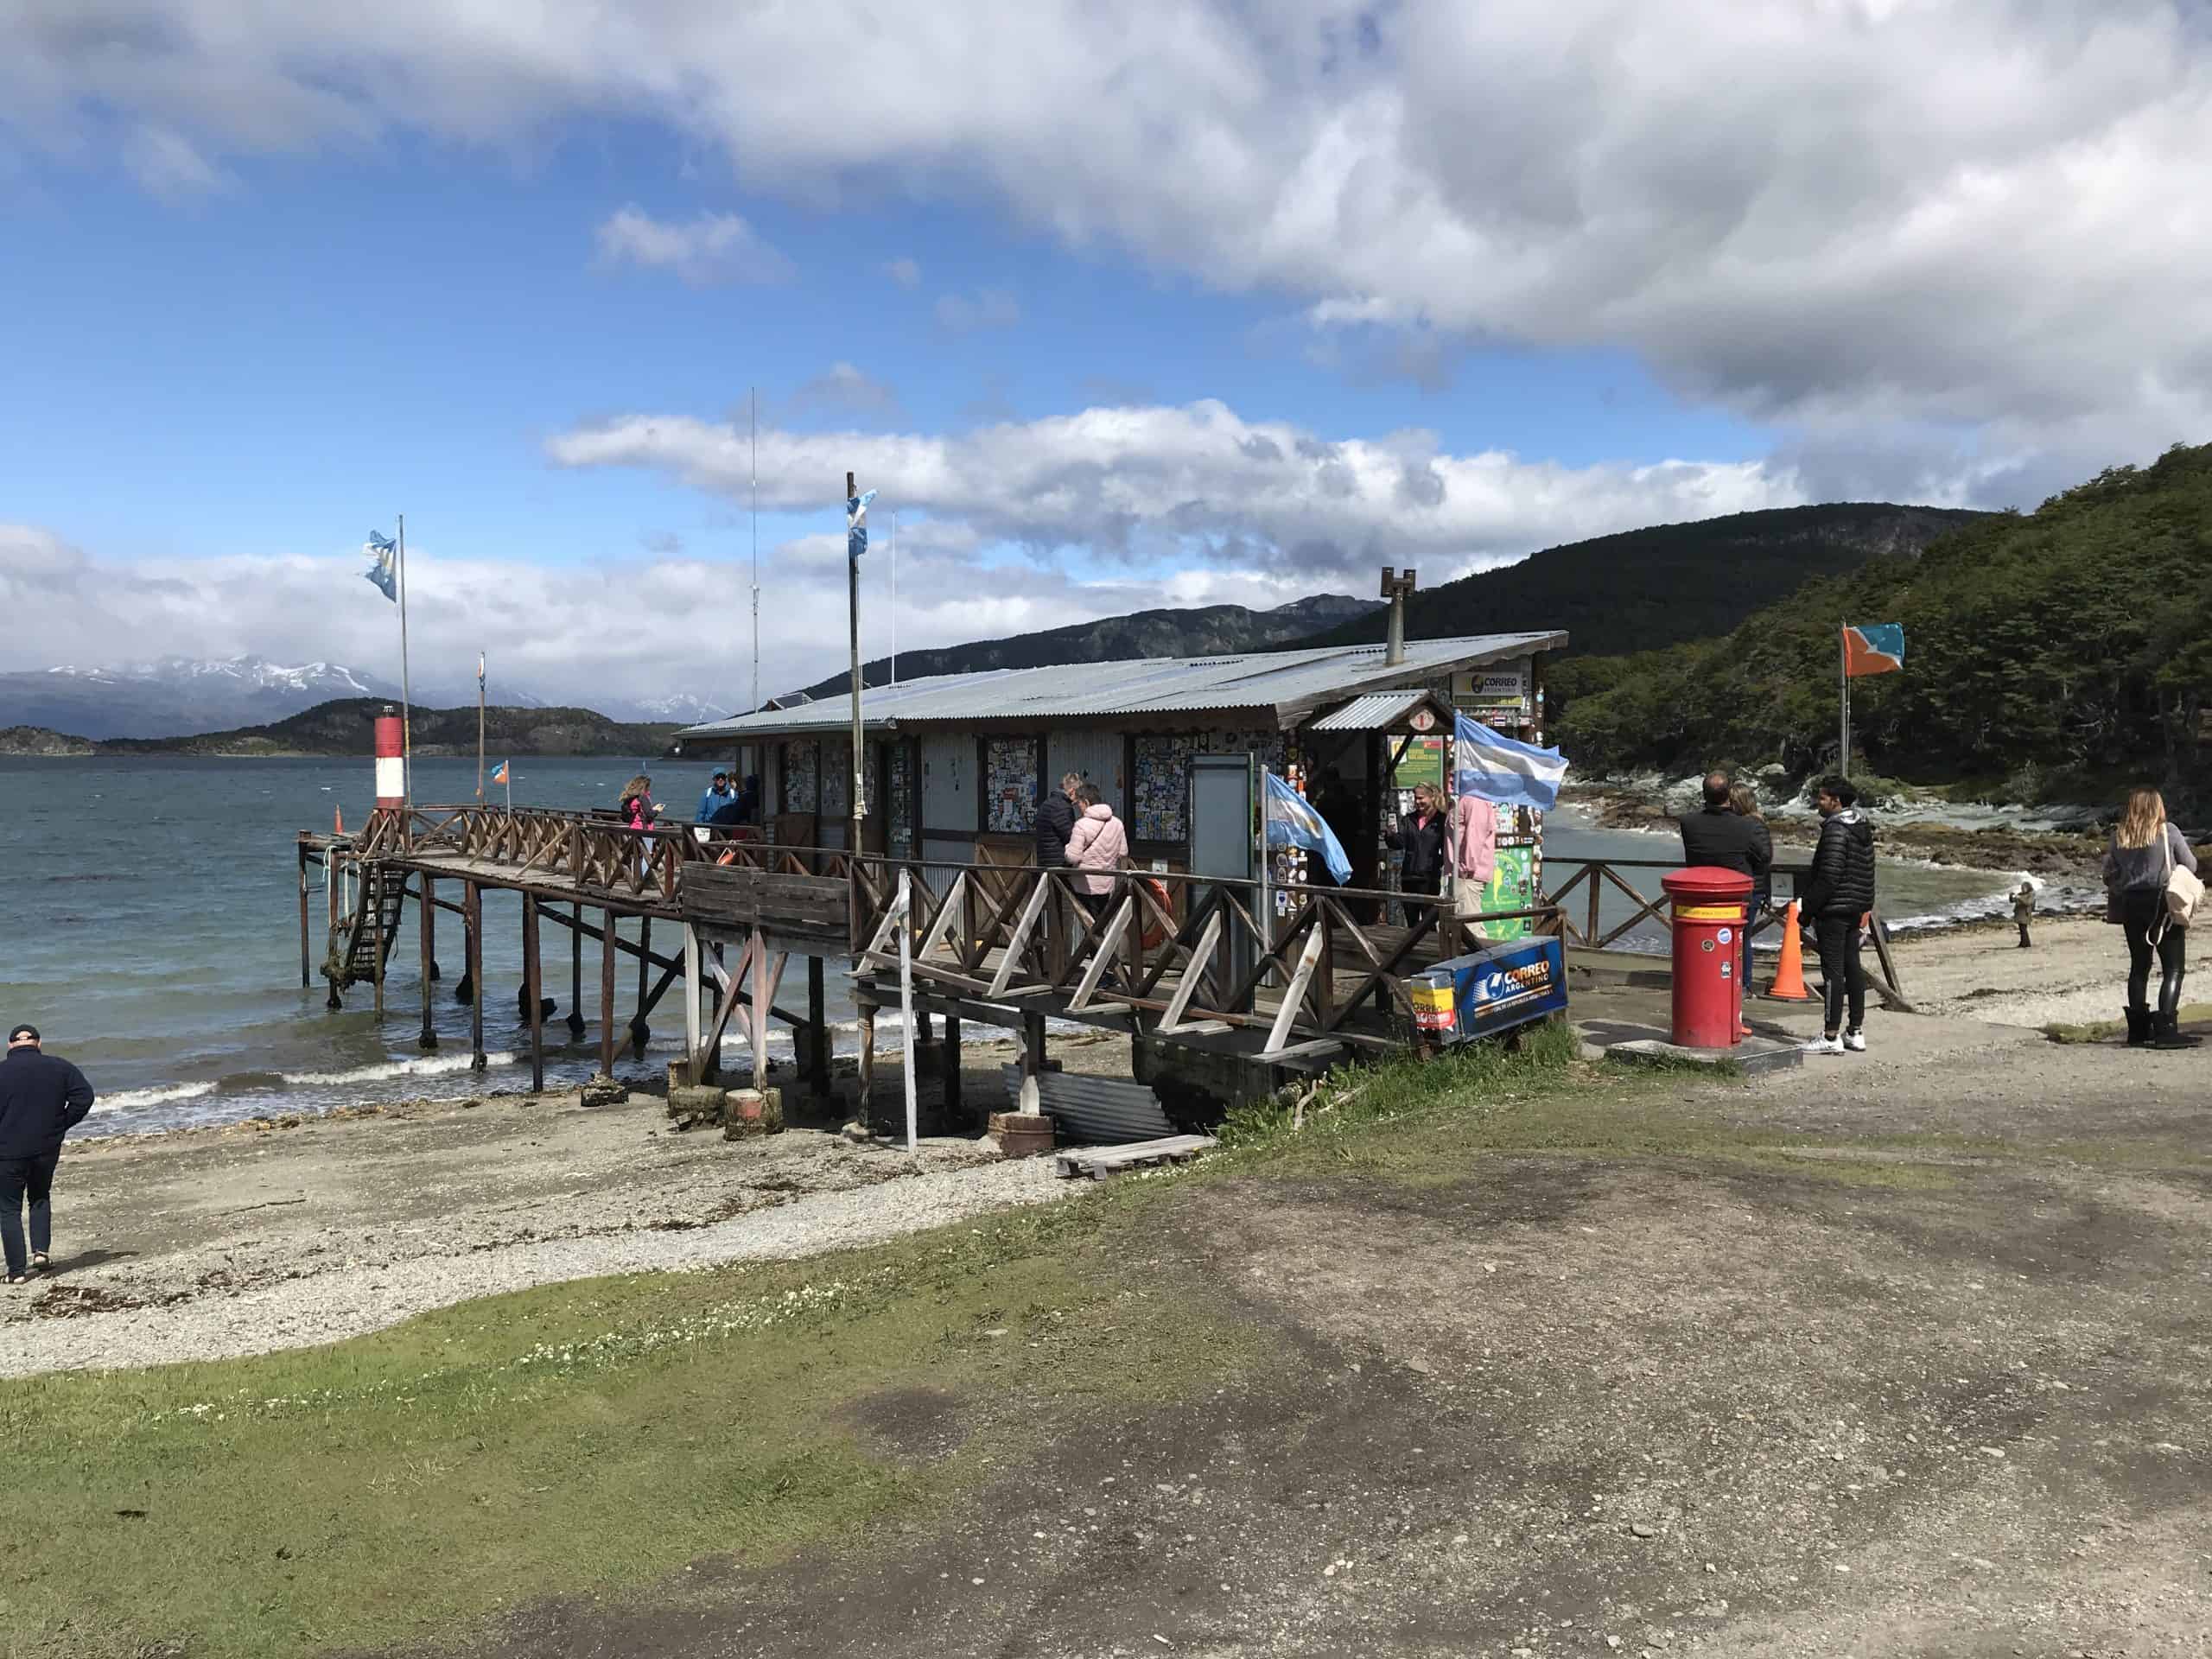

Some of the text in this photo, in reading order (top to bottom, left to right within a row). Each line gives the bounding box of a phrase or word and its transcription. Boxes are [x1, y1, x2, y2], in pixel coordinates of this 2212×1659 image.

[1484, 677, 1517, 687] CORREO
[1504, 960, 1550, 984] CORREO
[1505, 974, 1549, 994] ARGENTINO
